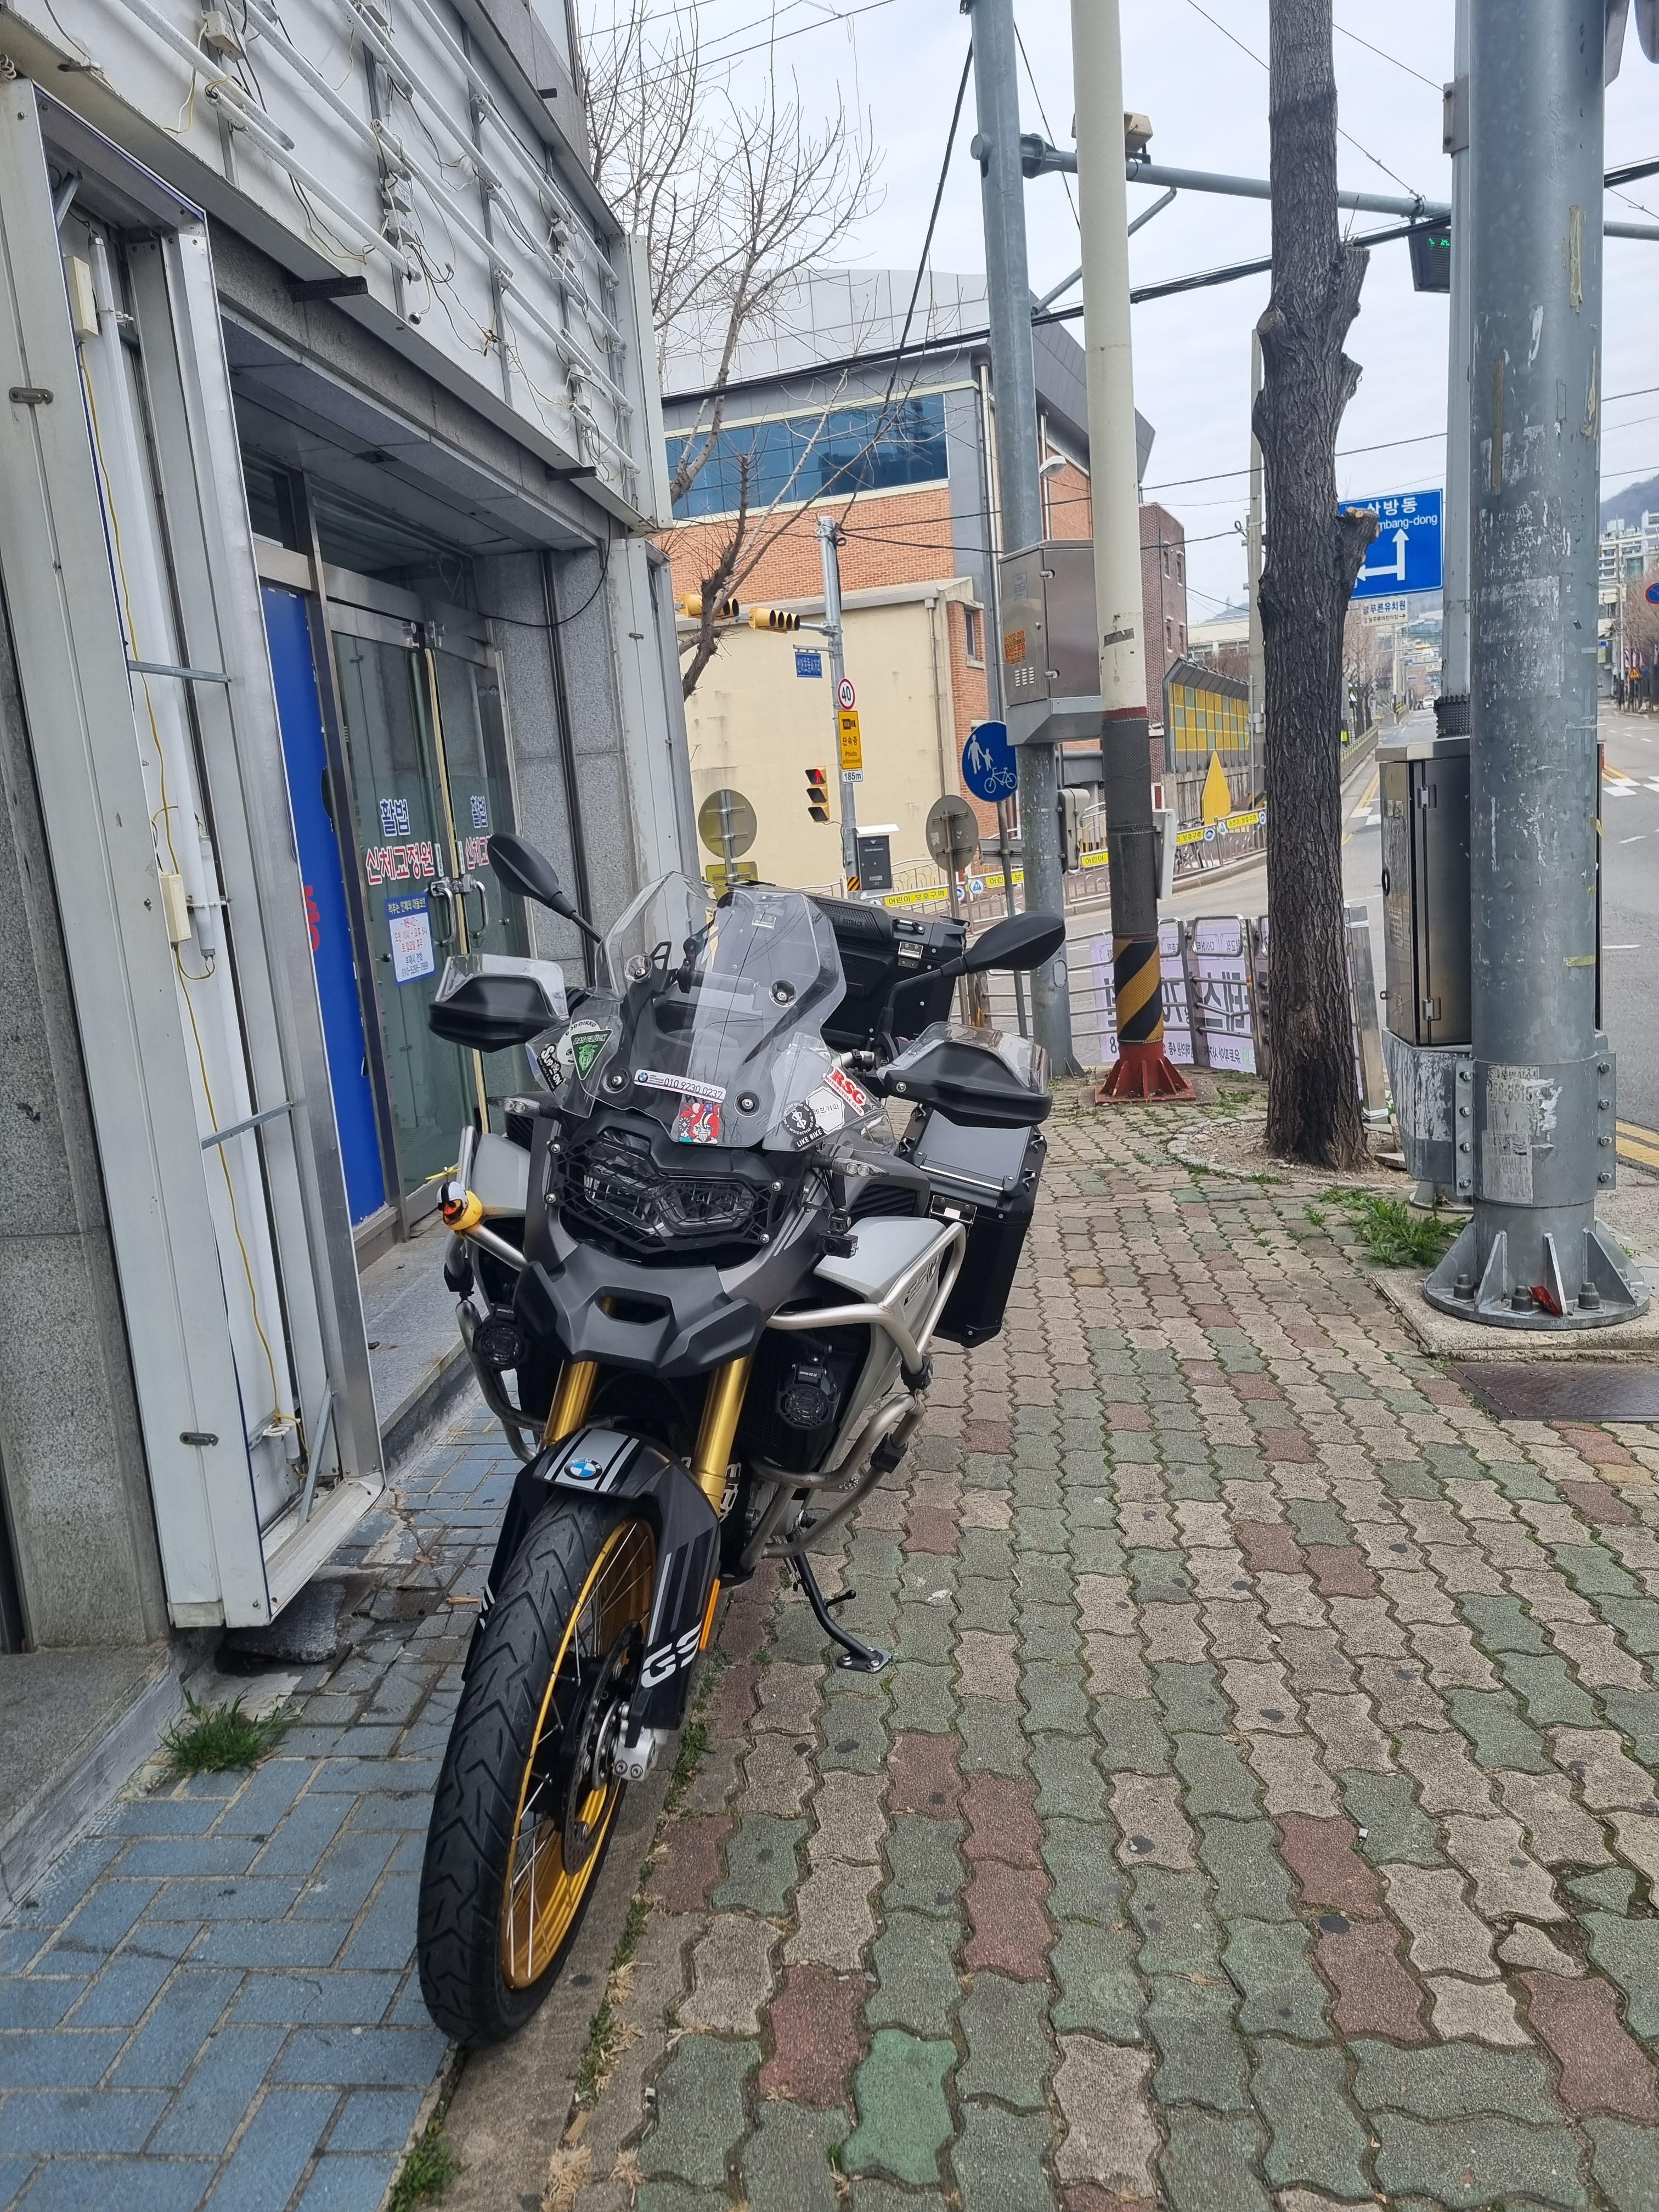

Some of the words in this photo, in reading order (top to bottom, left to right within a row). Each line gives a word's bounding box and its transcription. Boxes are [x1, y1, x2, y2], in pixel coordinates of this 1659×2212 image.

[1379, 515, 1438, 529] mbang-dong
[842, 686, 851, 702] 40
[843, 736, 858, 747] 단속중
[844, 771, 862, 782] 185m
[380, 798, 411, 837] 활법
[470, 795, 488, 829] 활법
[465, 834, 492, 870] 신체교
[1085, 855, 1104, 864] 어린이
[365, 841, 436, 886] 신체교정원
[990, 874, 1003, 884] 어린
[889, 895, 911, 905] 어린이
[915, 890, 945, 901] 보호구역
[573, 1036, 586, 1045] DAS
[664, 1078, 679, 1088] 010
[681, 1081, 701, 1093] 9230
[702, 1087, 723, 1099] 0237
[825, 1076, 852, 1103] MOTORCYCLE
[851, 1102, 862, 1114] CLUB
[831, 1069, 865, 1104] RSG
[796, 1136, 809, 1148] LIKE
[809, 1128, 823, 1140] BIKE
[641, 1619, 703, 1689] GS
